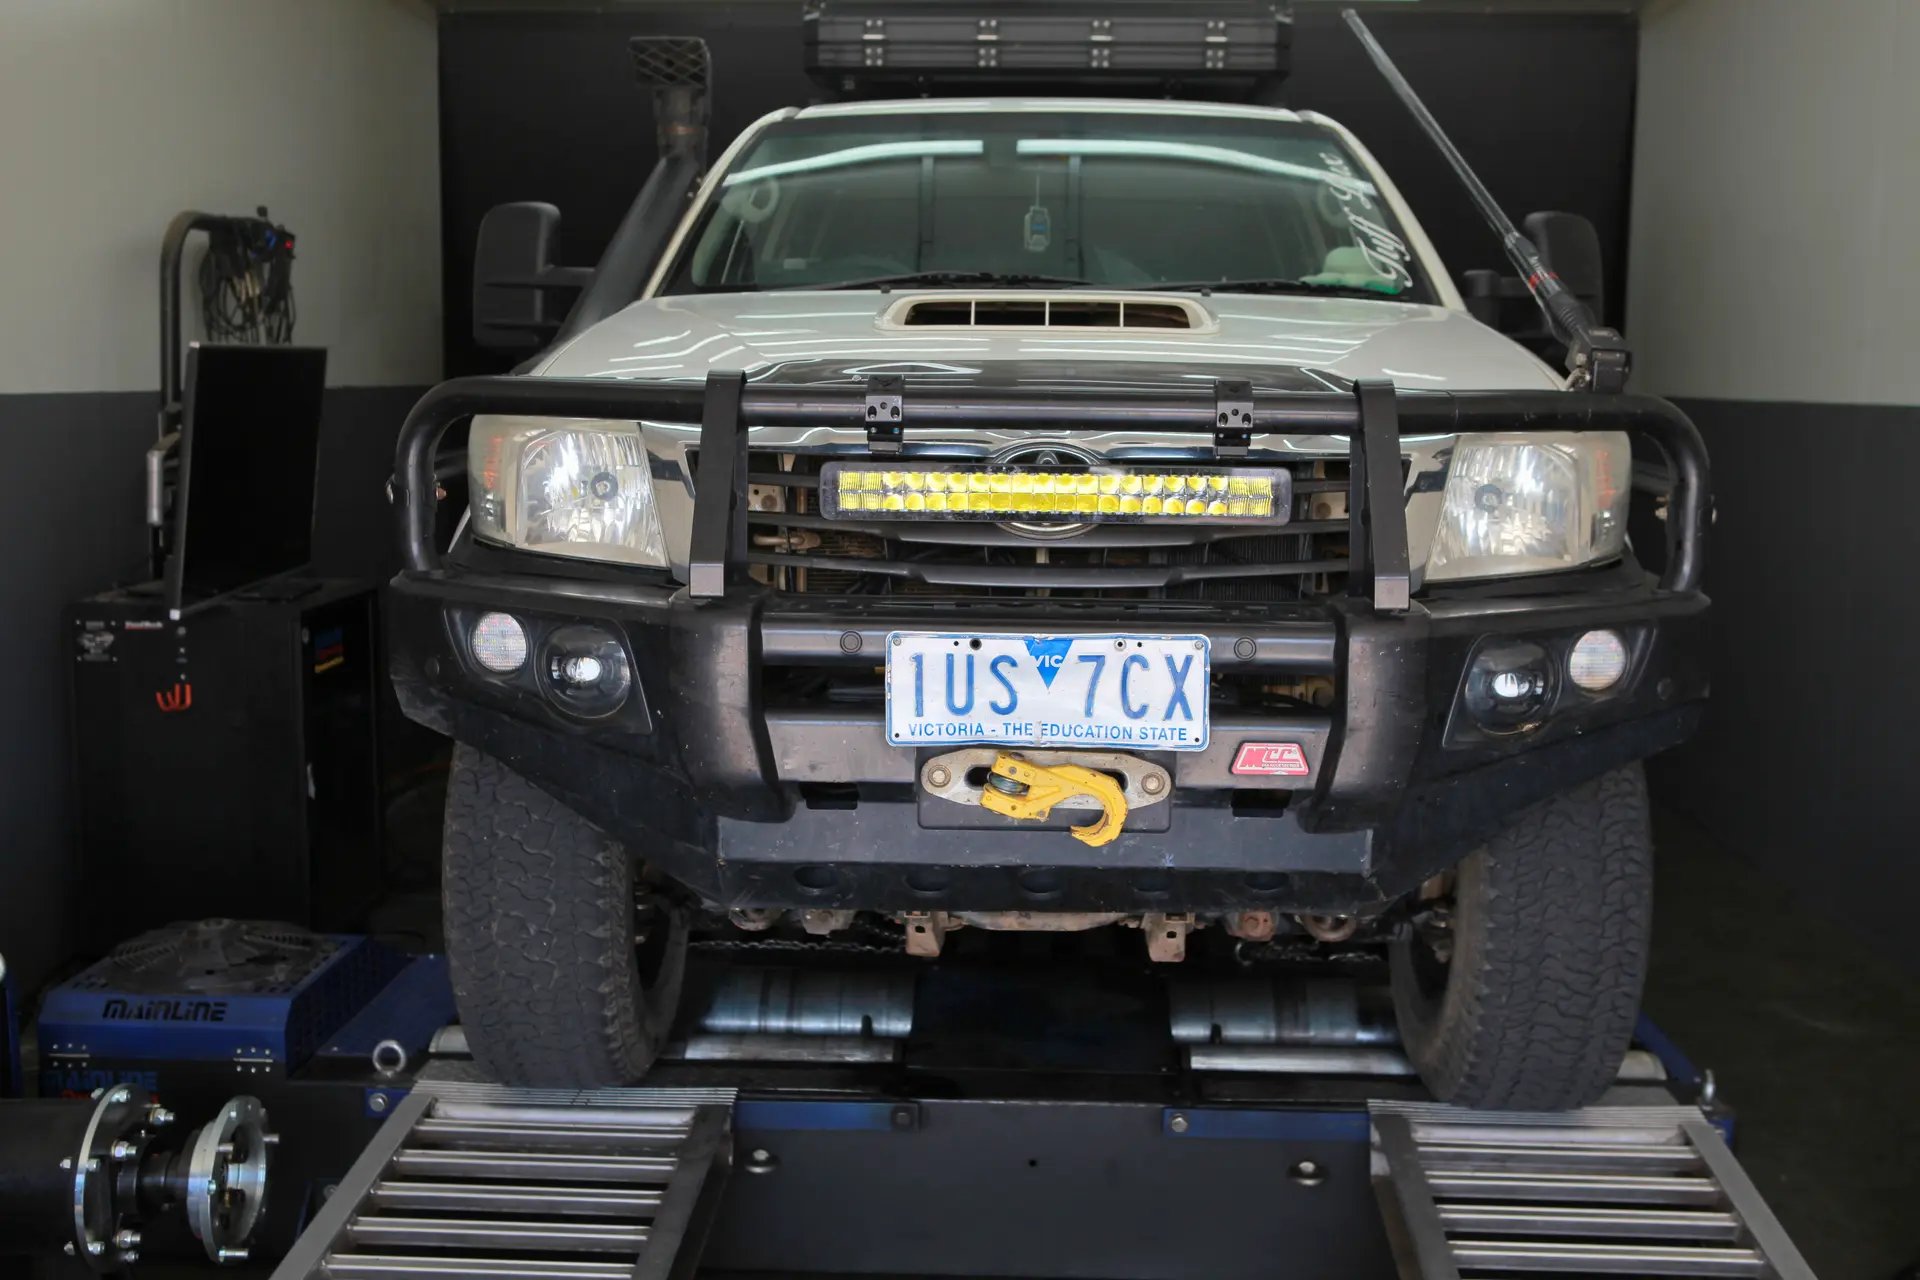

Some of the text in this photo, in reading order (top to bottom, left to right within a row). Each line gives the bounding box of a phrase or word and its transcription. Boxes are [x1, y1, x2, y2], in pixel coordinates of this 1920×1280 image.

[1031, 654, 1064, 668] VIC
[910, 652, 1194, 721] 1US 7CX
[908, 722, 985, 737] VICTORIA
[1002, 722, 1034, 737] THE
[1040, 722, 1133, 740] EDUCATION
[1138, 726, 1188, 741] STATE
